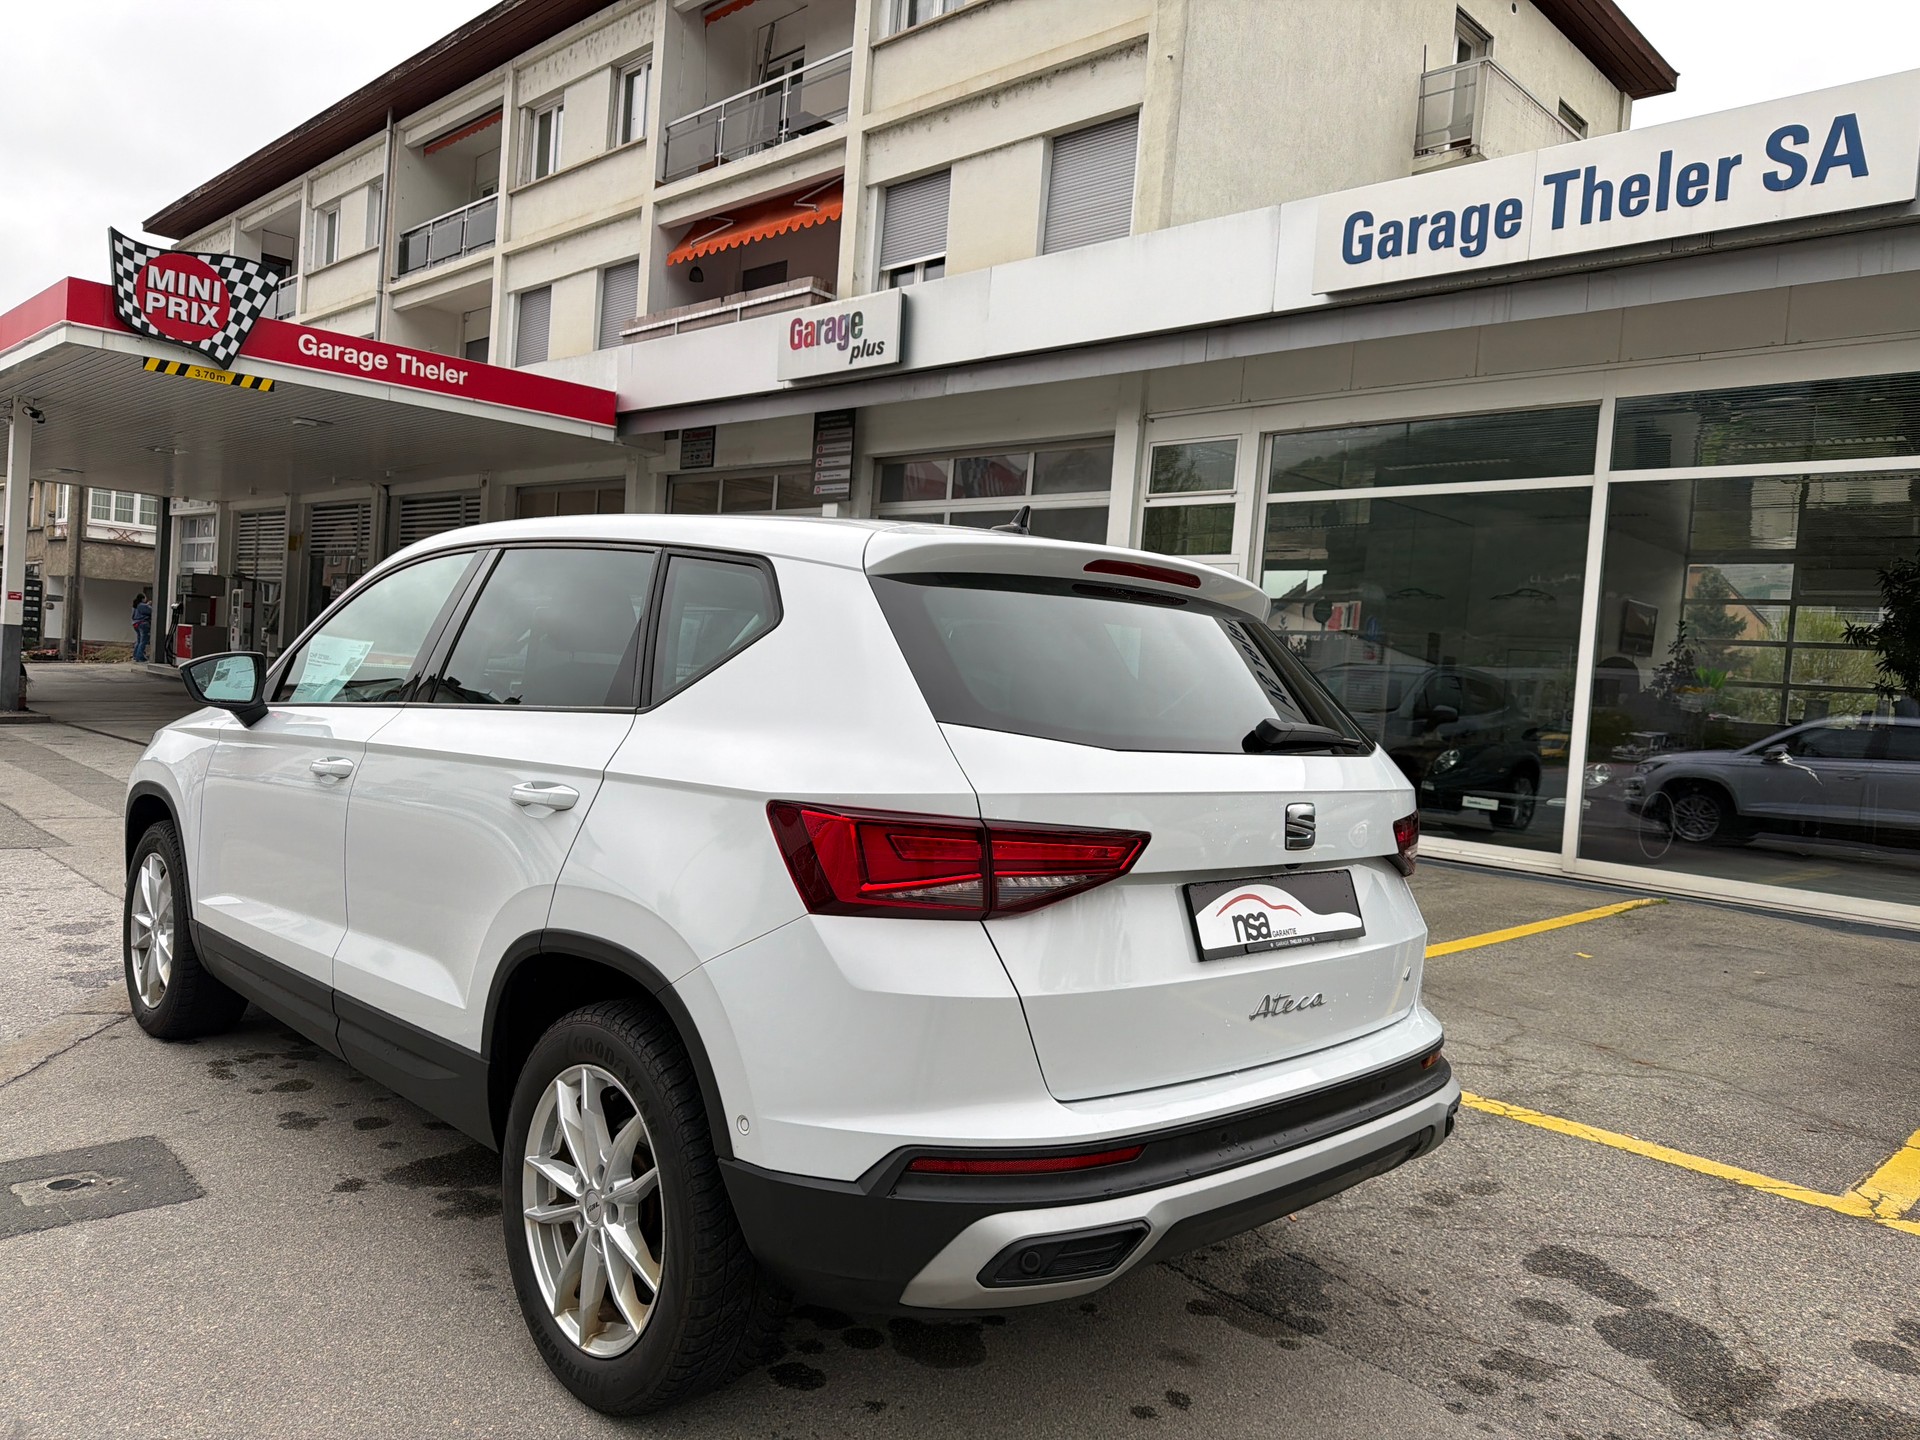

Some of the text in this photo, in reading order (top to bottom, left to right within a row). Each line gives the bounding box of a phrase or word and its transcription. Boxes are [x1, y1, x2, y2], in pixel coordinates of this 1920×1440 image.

[1341, 113, 1869, 265] Garage Theler SA
[147, 265, 222, 303] MINI
[145, 291, 220, 329] PRIX
[789, 311, 864, 351] Garage
[298, 333, 468, 385] Garage Theler
[849, 339, 885, 364] plus
[1232, 911, 1272, 942] nsa
[1272, 928, 1297, 937] GARANTIE
[1249, 992, 1327, 1021] Ateca
